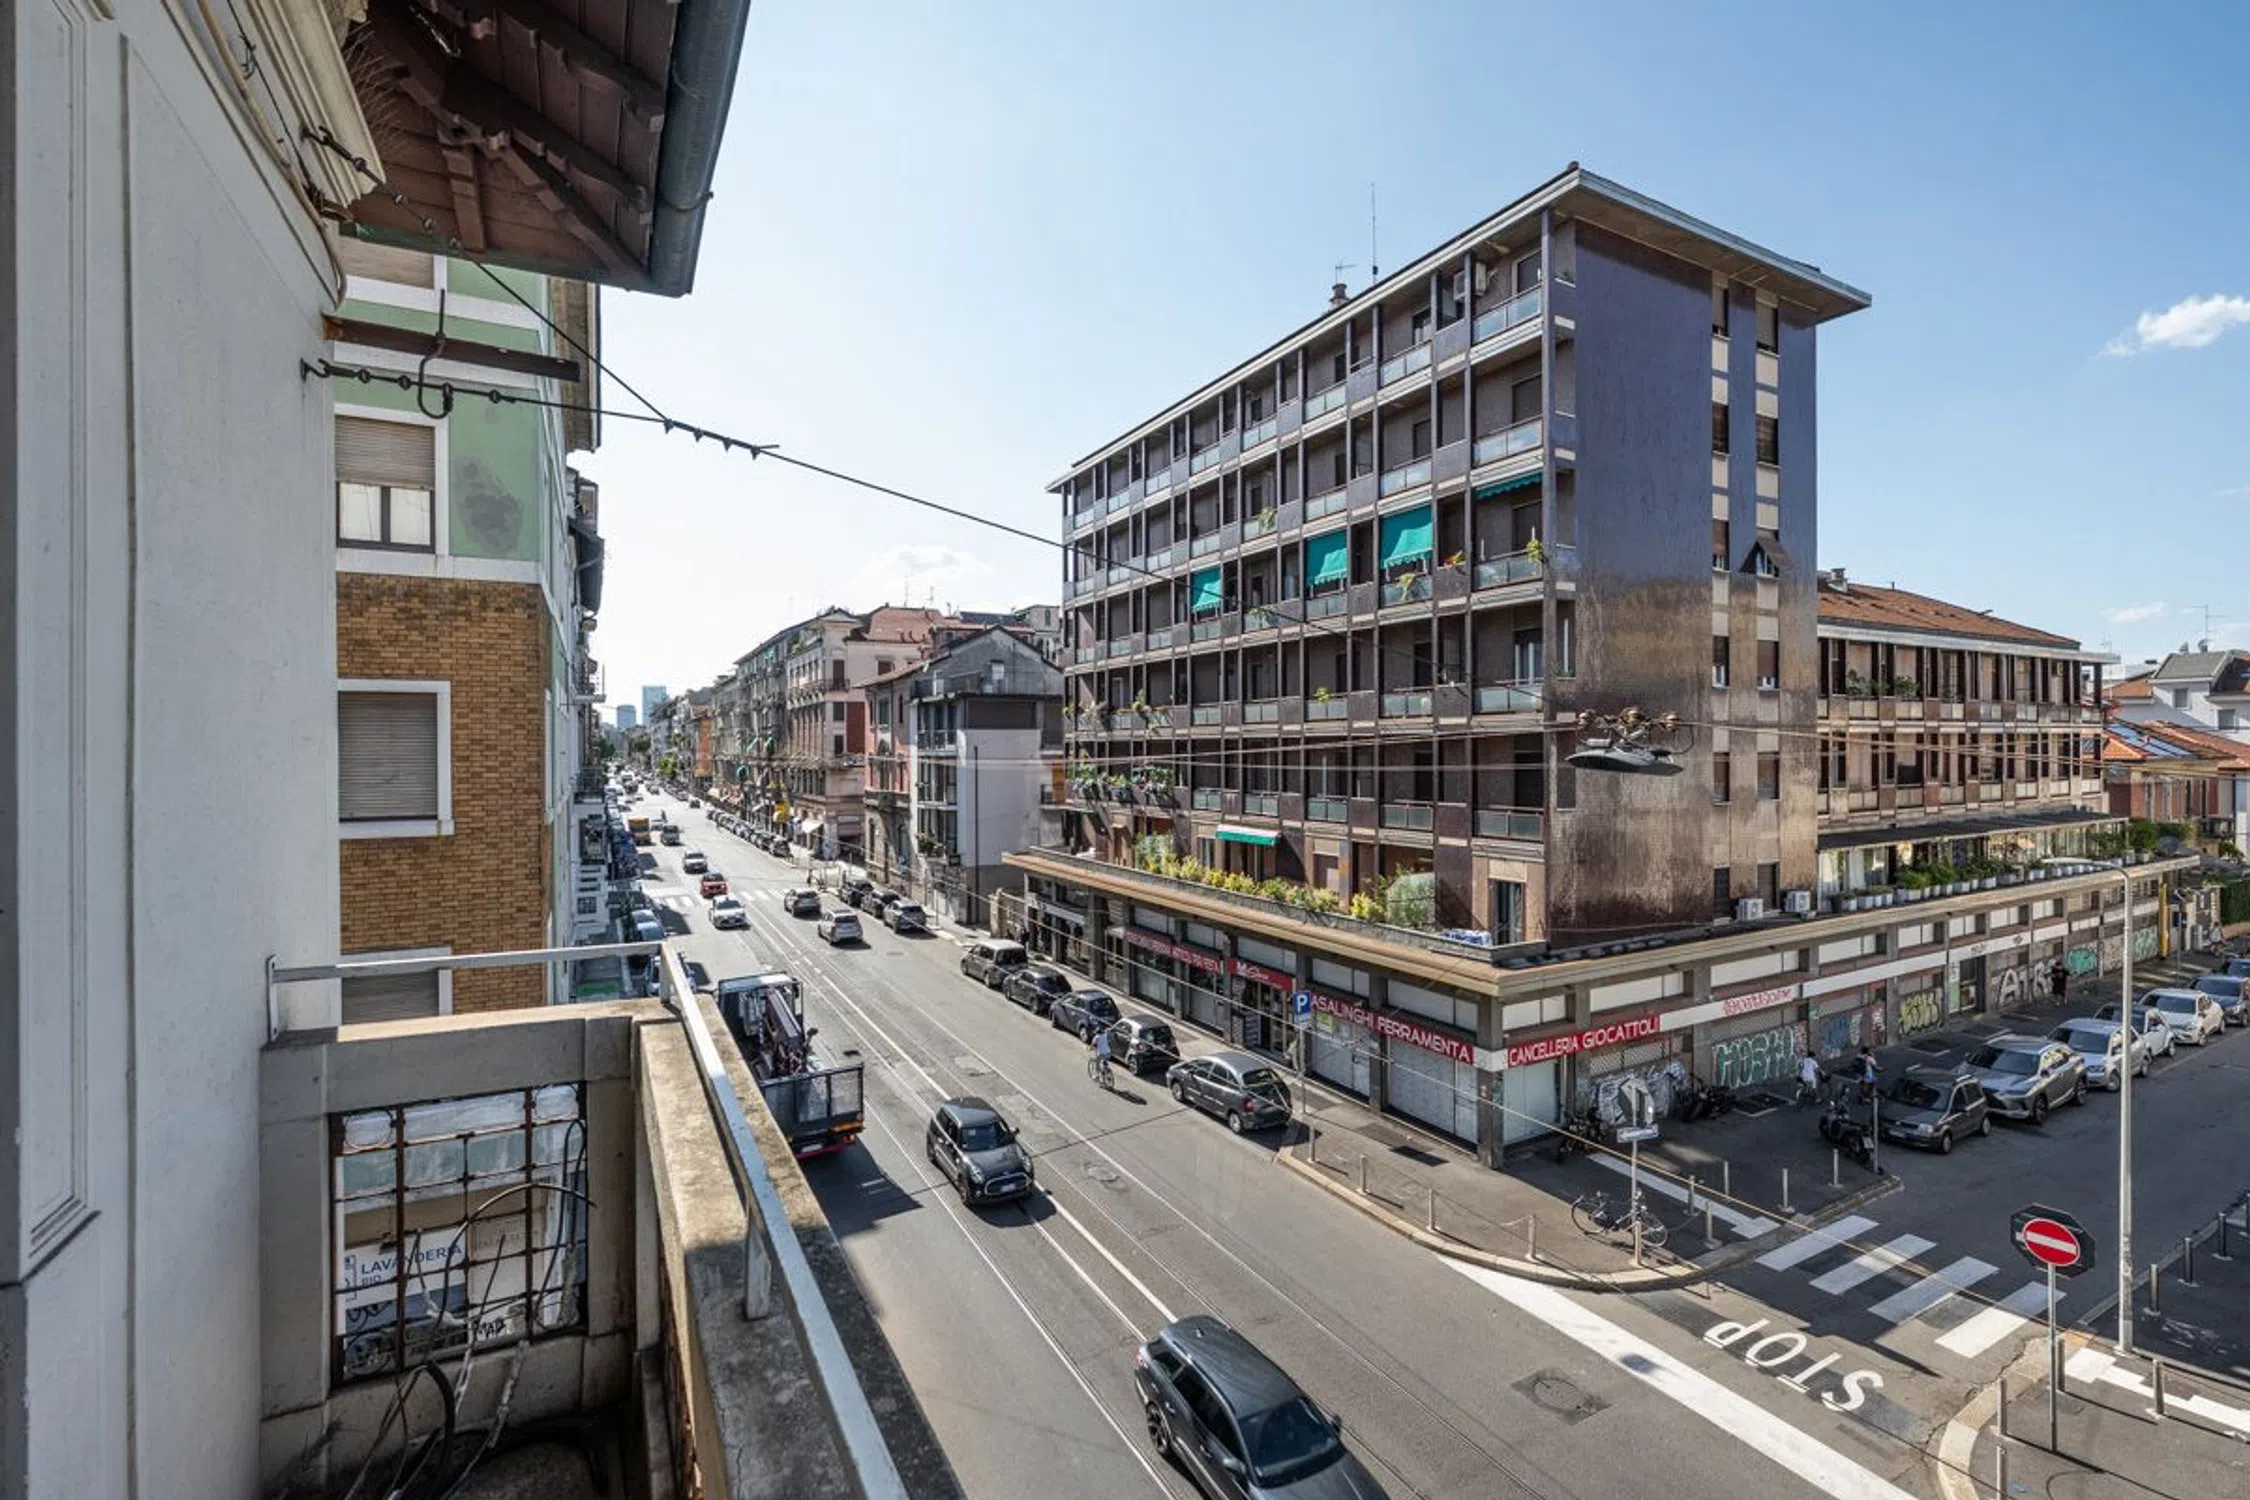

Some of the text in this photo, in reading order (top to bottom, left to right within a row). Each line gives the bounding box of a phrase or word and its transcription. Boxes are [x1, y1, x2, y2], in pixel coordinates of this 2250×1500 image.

[1297, 993, 1308, 1013] P
[1310, 994, 1470, 1063] ASALINGHI FERRAMENTA
[1508, 1016, 1659, 1067] CANCELLERIA GIOCATTOLI
[361, 1246, 462, 1275] LAVDERA
[1703, 1318, 1884, 1412] STOP
